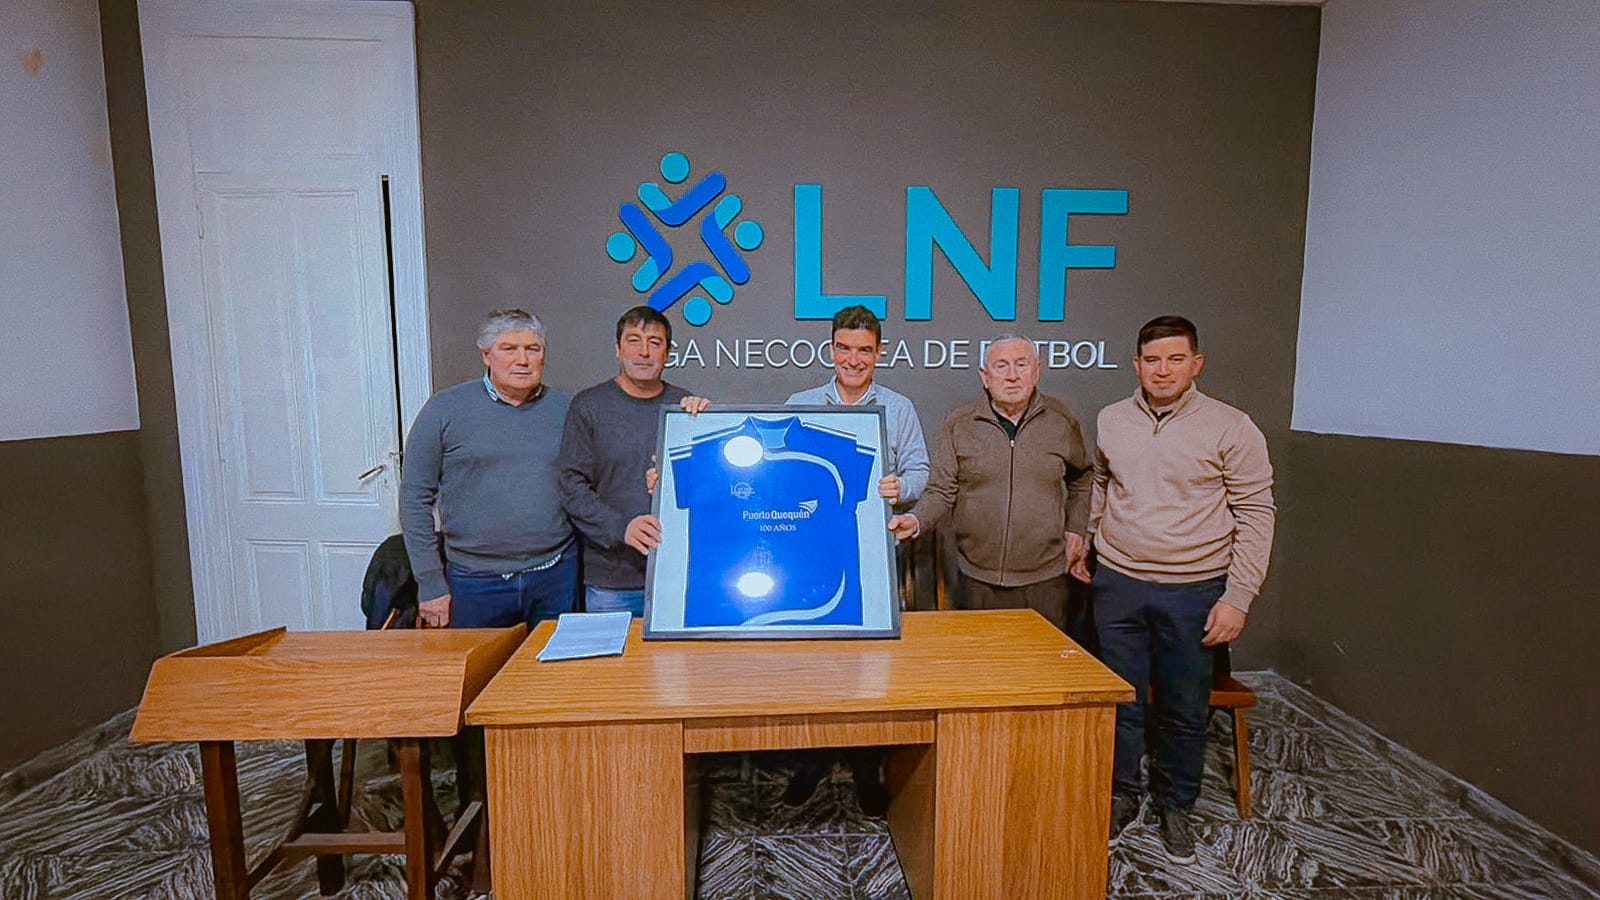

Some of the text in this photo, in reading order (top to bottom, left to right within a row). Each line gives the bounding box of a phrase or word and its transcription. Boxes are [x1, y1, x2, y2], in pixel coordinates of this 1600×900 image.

[794, 184, 1129, 321] LNF
[715, 338, 915, 368] NECOCEA
[923, 339, 970, 368] DE
[979, 340, 1118, 369] FTBOL
[760, 522, 797, 532] 100 AÑOS
